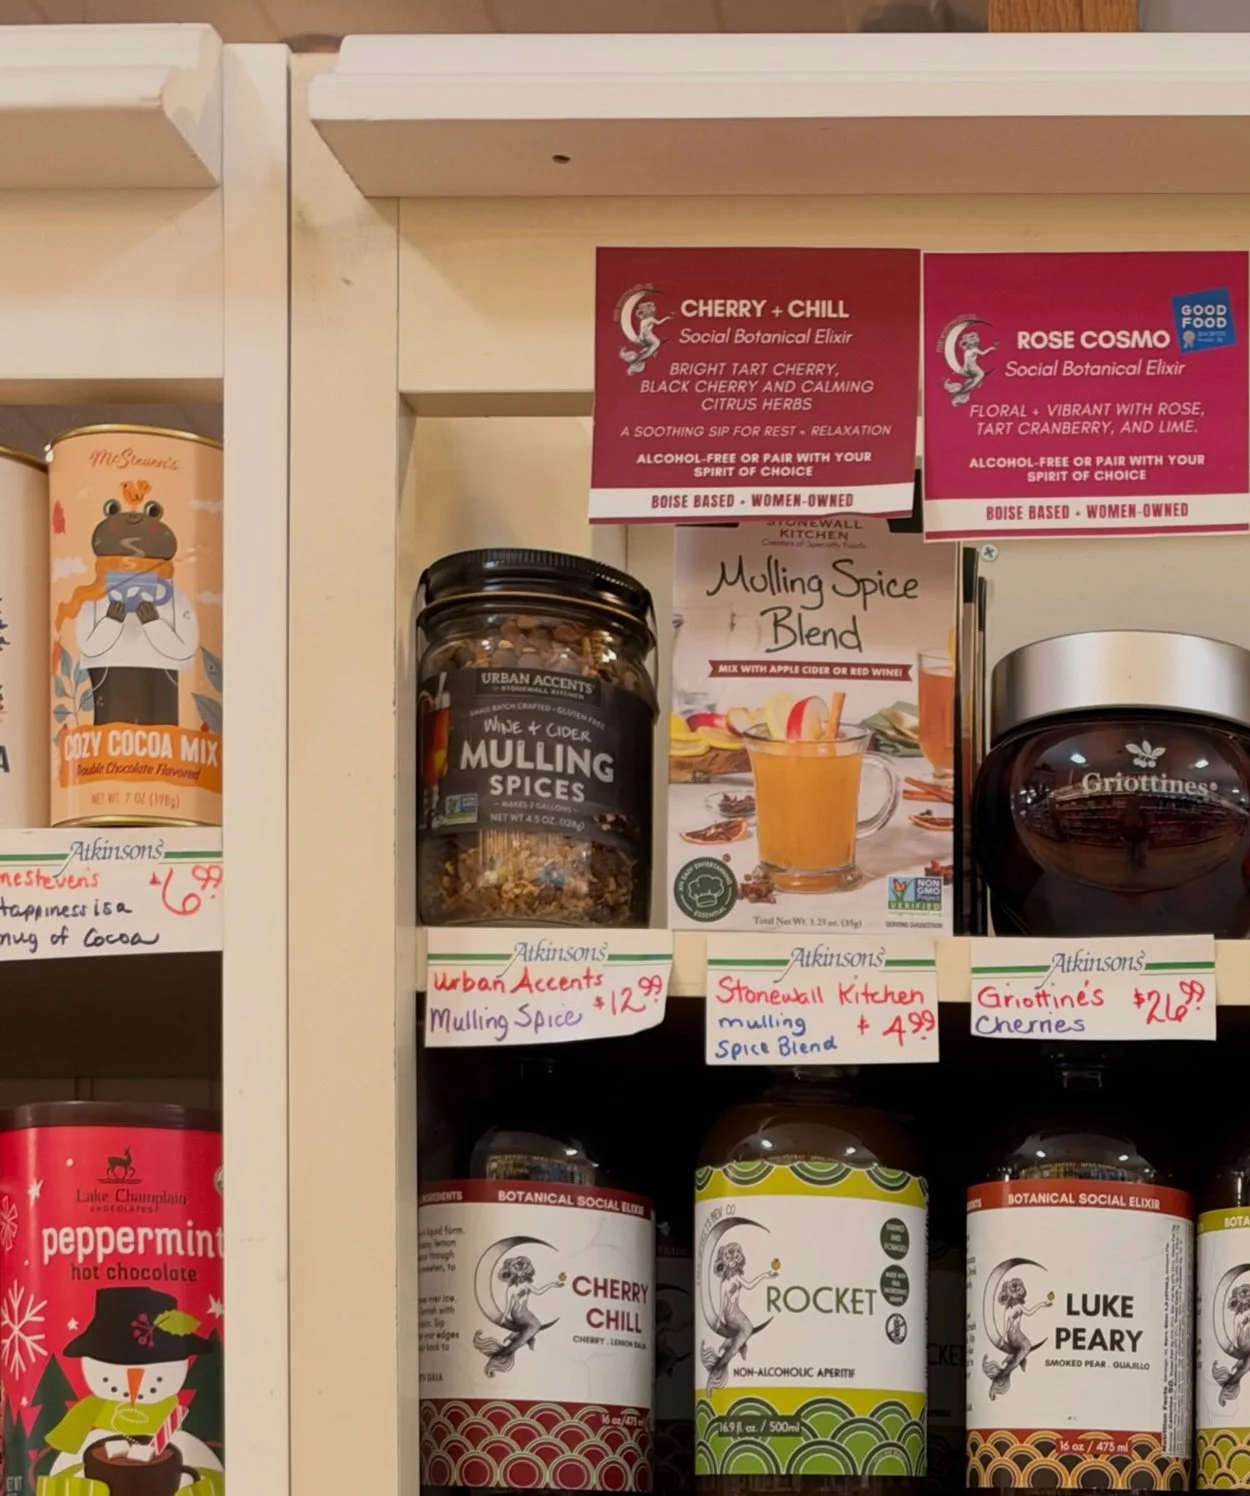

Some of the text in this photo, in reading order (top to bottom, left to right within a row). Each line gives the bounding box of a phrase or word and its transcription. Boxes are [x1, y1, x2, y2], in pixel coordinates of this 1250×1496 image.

[680, 300, 849, 318] CHERRY CHILL
[1181, 305, 1227, 317] GOOD
[1183, 317, 1227, 329] FOOD
[680, 328, 853, 345] Social Botanical Elixir
[1017, 331, 1170, 349] ROSE COSMO
[669, 362, 767, 376] BRIGHT TART
[977, 420, 1154, 436] TART CRANBERRY, AND
[780, 528, 849, 539] KITCHEN
[707, 559, 919, 600] Mulling Spice
[761, 608, 863, 652] Blend
[719, 664, 738, 674] MIX
[741, 665, 767, 674] WITH
[770, 665, 800, 675] APPLE
[802, 666, 832, 676] CIDER
[835, 667, 849, 677] OR
[852, 667, 870, 677] RED
[482, 673, 593, 694] URBAN ACCENTS
[64, 730, 218, 766] COZY COCOA MIX
[461, 740, 614, 783] MULLING
[490, 775, 585, 802] SPICES
[511, 968, 603, 991] Accents
[716, 977, 924, 1004] Stonewall Kitchen
[76, 1188, 186, 1205] Lake Champlain
[42, 1221, 224, 1264] peppermint
[70, 1263, 198, 1282] hot chocolate
[572, 1276, 648, 1303] CHERRY
[766, 1286, 877, 1315] ROCKET
[1066, 1294, 1134, 1318] LUKE
[586, 1307, 642, 1334] CHILL
[1055, 1328, 1143, 1353] PEARY
[733, 1367, 855, 1378] NON-ALCOHOLIC APERITIF
[1045, 1359, 1150, 1370] SMOKED PEAR GUAJILLO
